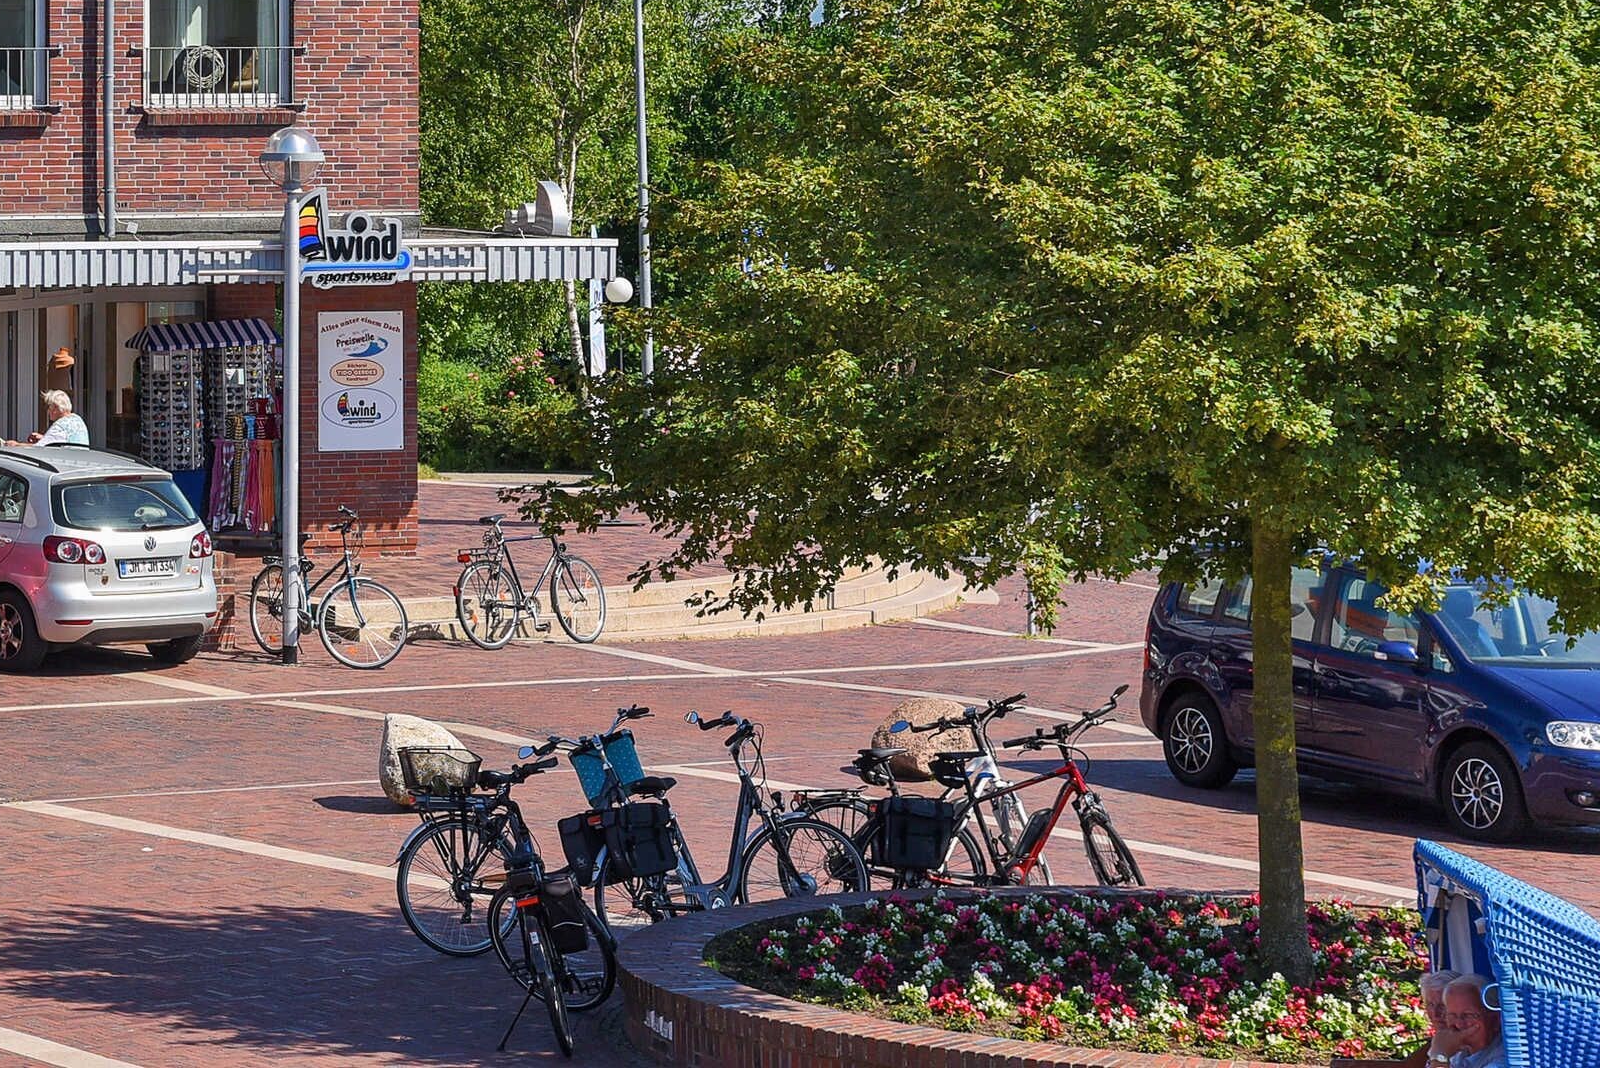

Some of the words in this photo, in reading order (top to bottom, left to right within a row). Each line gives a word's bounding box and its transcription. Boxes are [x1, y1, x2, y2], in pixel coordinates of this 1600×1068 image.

[326, 216, 398, 262] wind
[316, 271, 397, 287] sportswear
[383, 322, 401, 334] Dach
[336, 333, 375, 348] Preiswelle
[349, 400, 377, 417] wind
